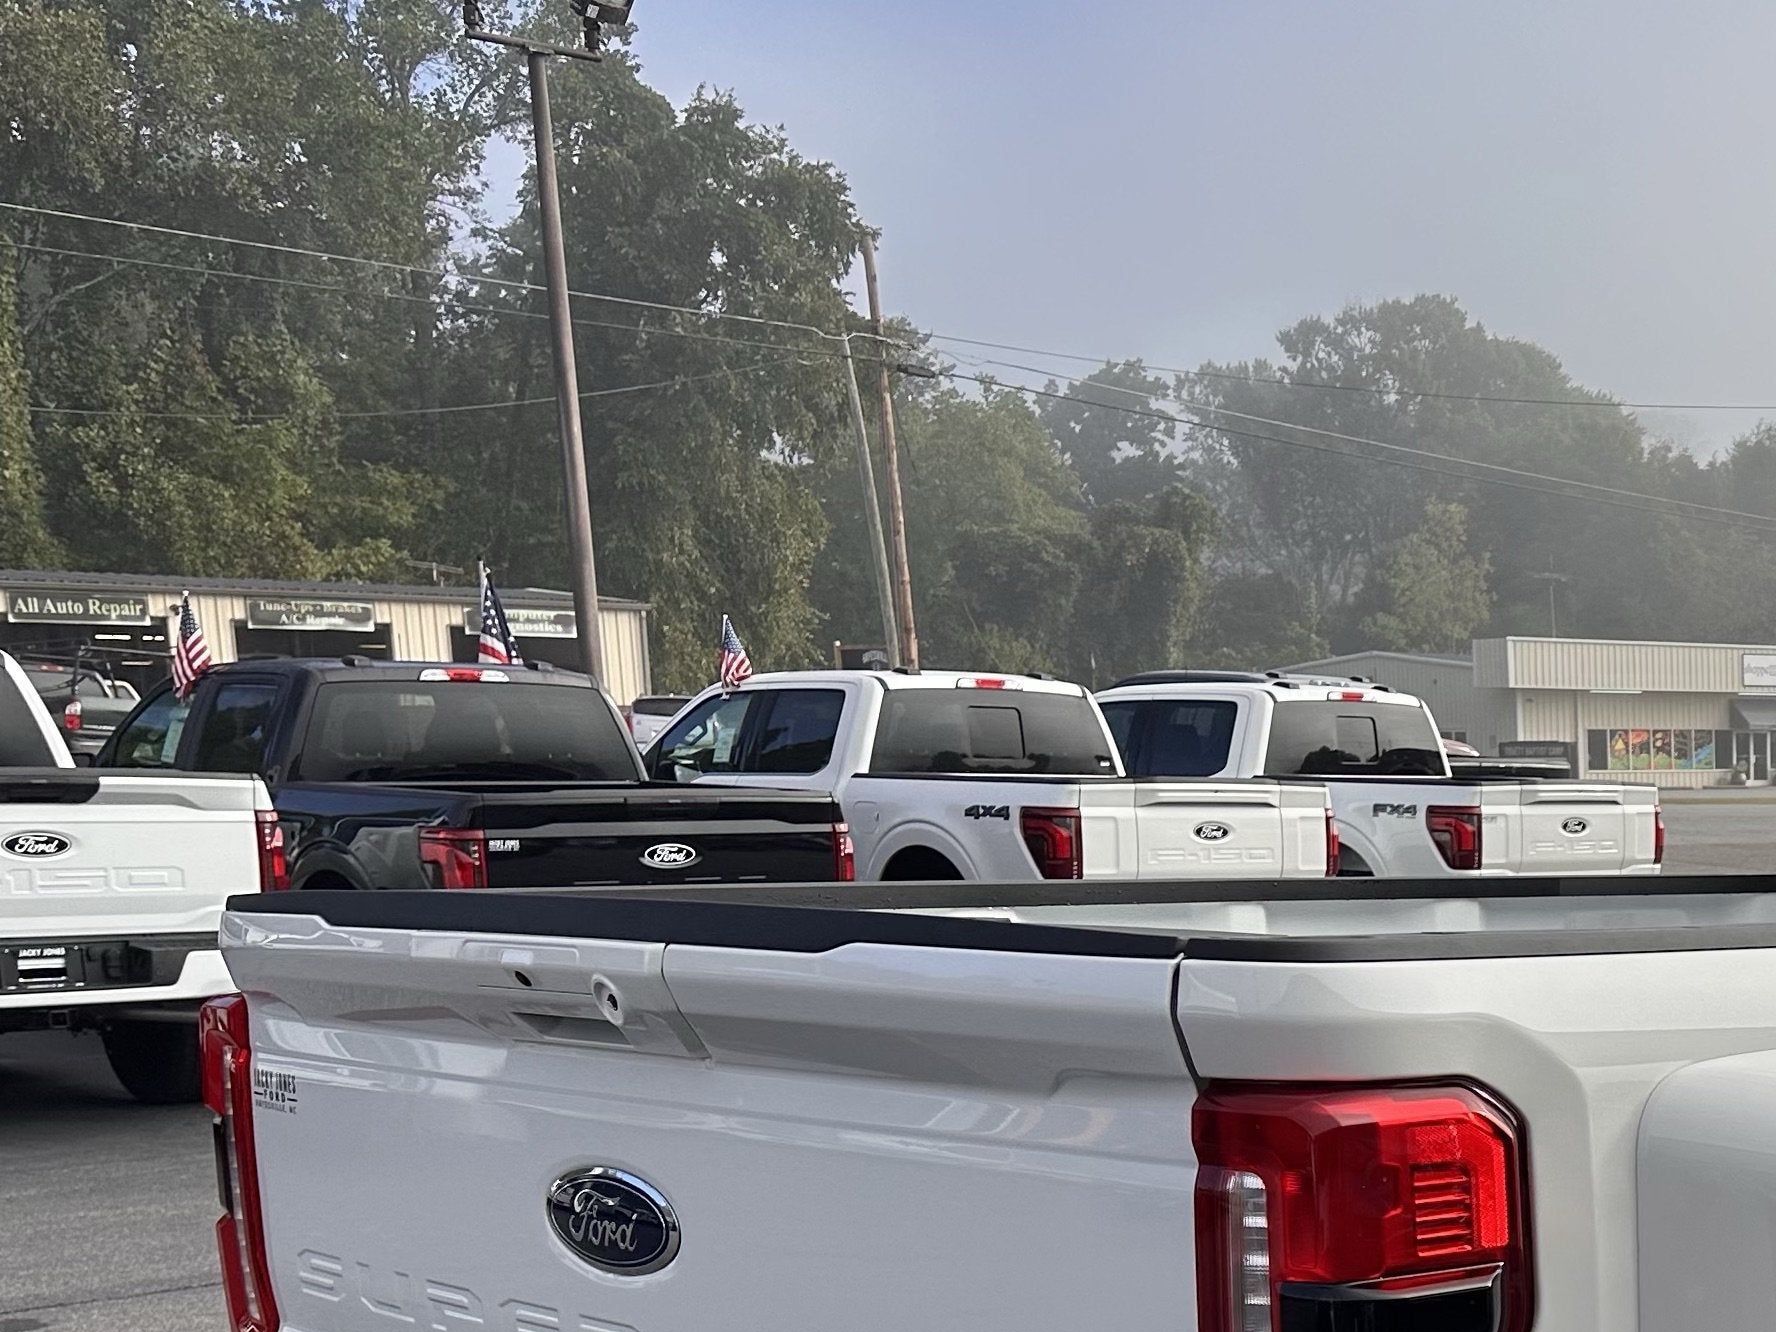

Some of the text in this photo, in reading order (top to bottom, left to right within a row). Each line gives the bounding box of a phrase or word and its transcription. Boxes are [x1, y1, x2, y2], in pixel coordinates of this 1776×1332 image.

[14, 597, 144, 620] All Auto Repair
[1372, 803, 1418, 818] FX4
[15, 835, 58, 853] Ford
[653, 845, 687, 862] Ford
[1148, 847, 1275, 864] F-150
[264, 1089, 286, 1103] FORD
[568, 1188, 638, 1252] Ford
